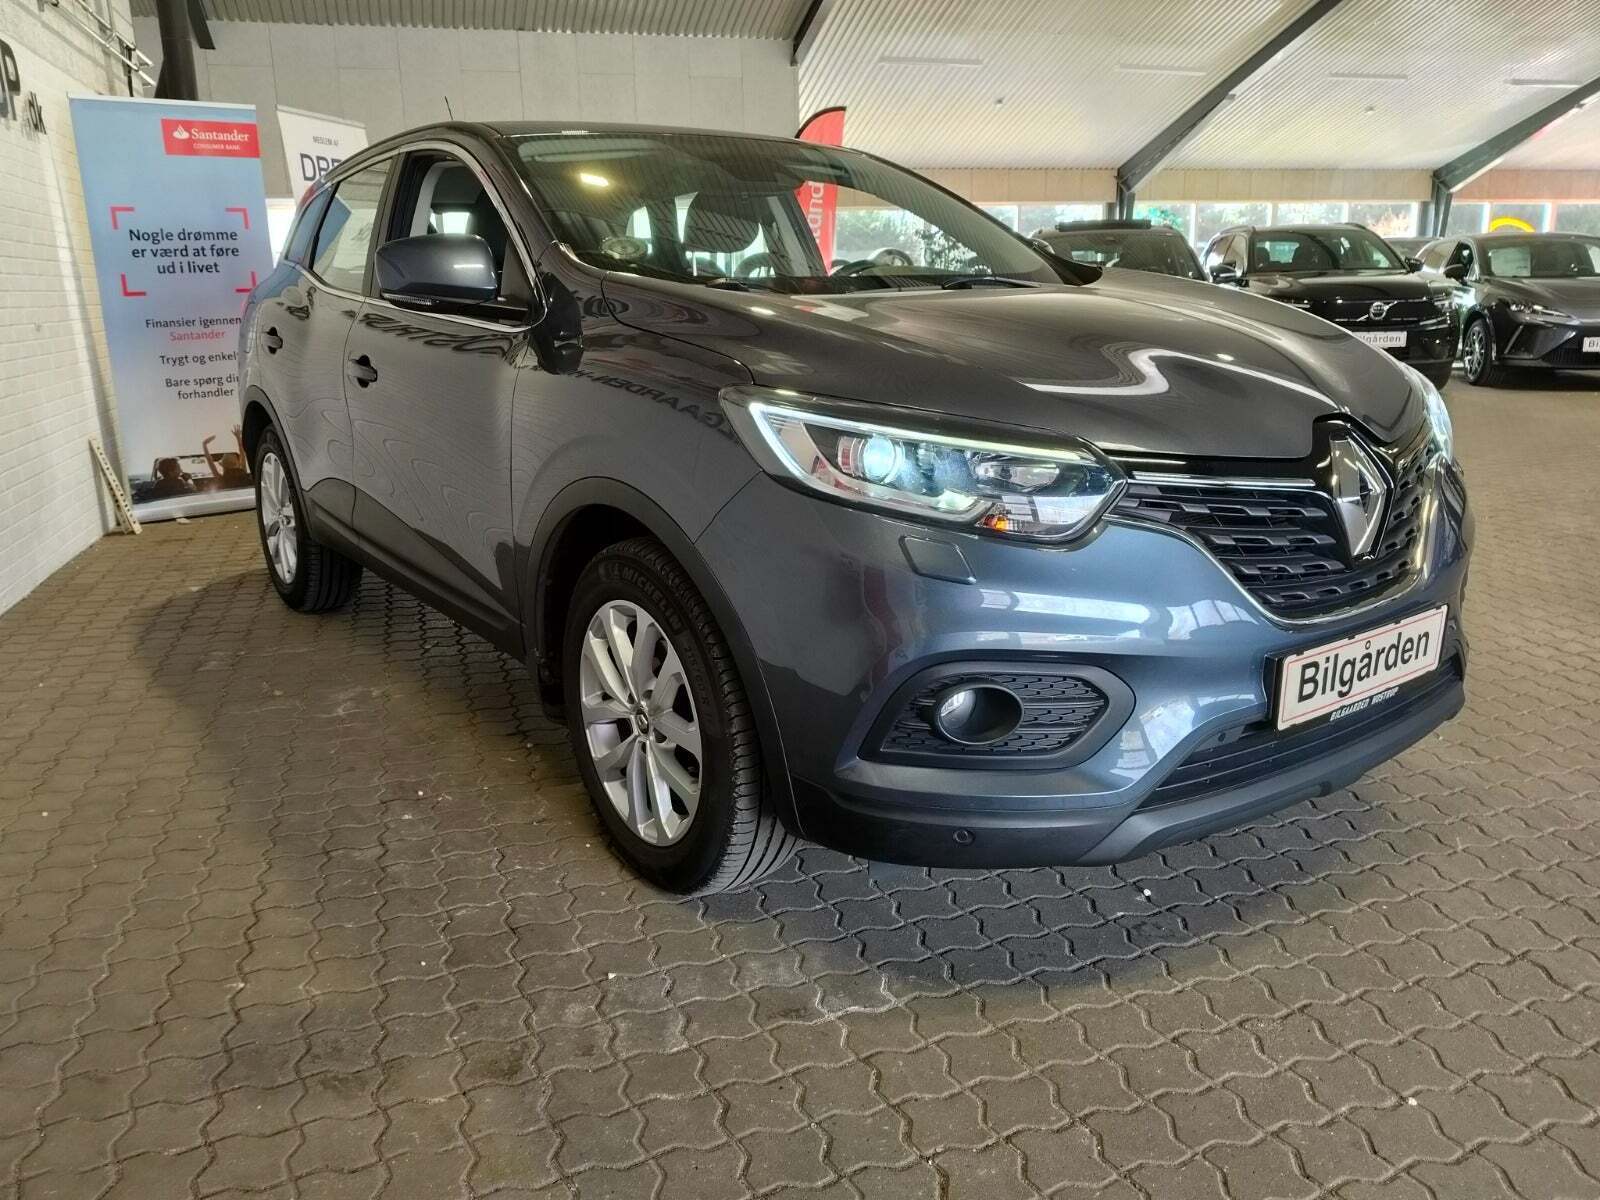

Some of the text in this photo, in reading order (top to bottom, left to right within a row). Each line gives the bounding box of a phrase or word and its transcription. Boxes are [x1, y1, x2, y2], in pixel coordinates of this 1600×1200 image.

[191, 128, 249, 142] Santander
[129, 228, 238, 244] Nogle drømme
[132, 245, 240, 258] er værd at føre
[157, 261, 220, 275] ud i livet
[145, 317, 196, 329] Finansier
[169, 330, 225, 342] Santander
[159, 351, 239, 366] Trygt og enkel
[165, 377, 191, 388] Bare
[193, 375, 223, 388] spørg
[178, 387, 235, 400] forhandler
[621, 565, 684, 635] MICHELIN
[1297, 631, 1430, 703] Bilgården
